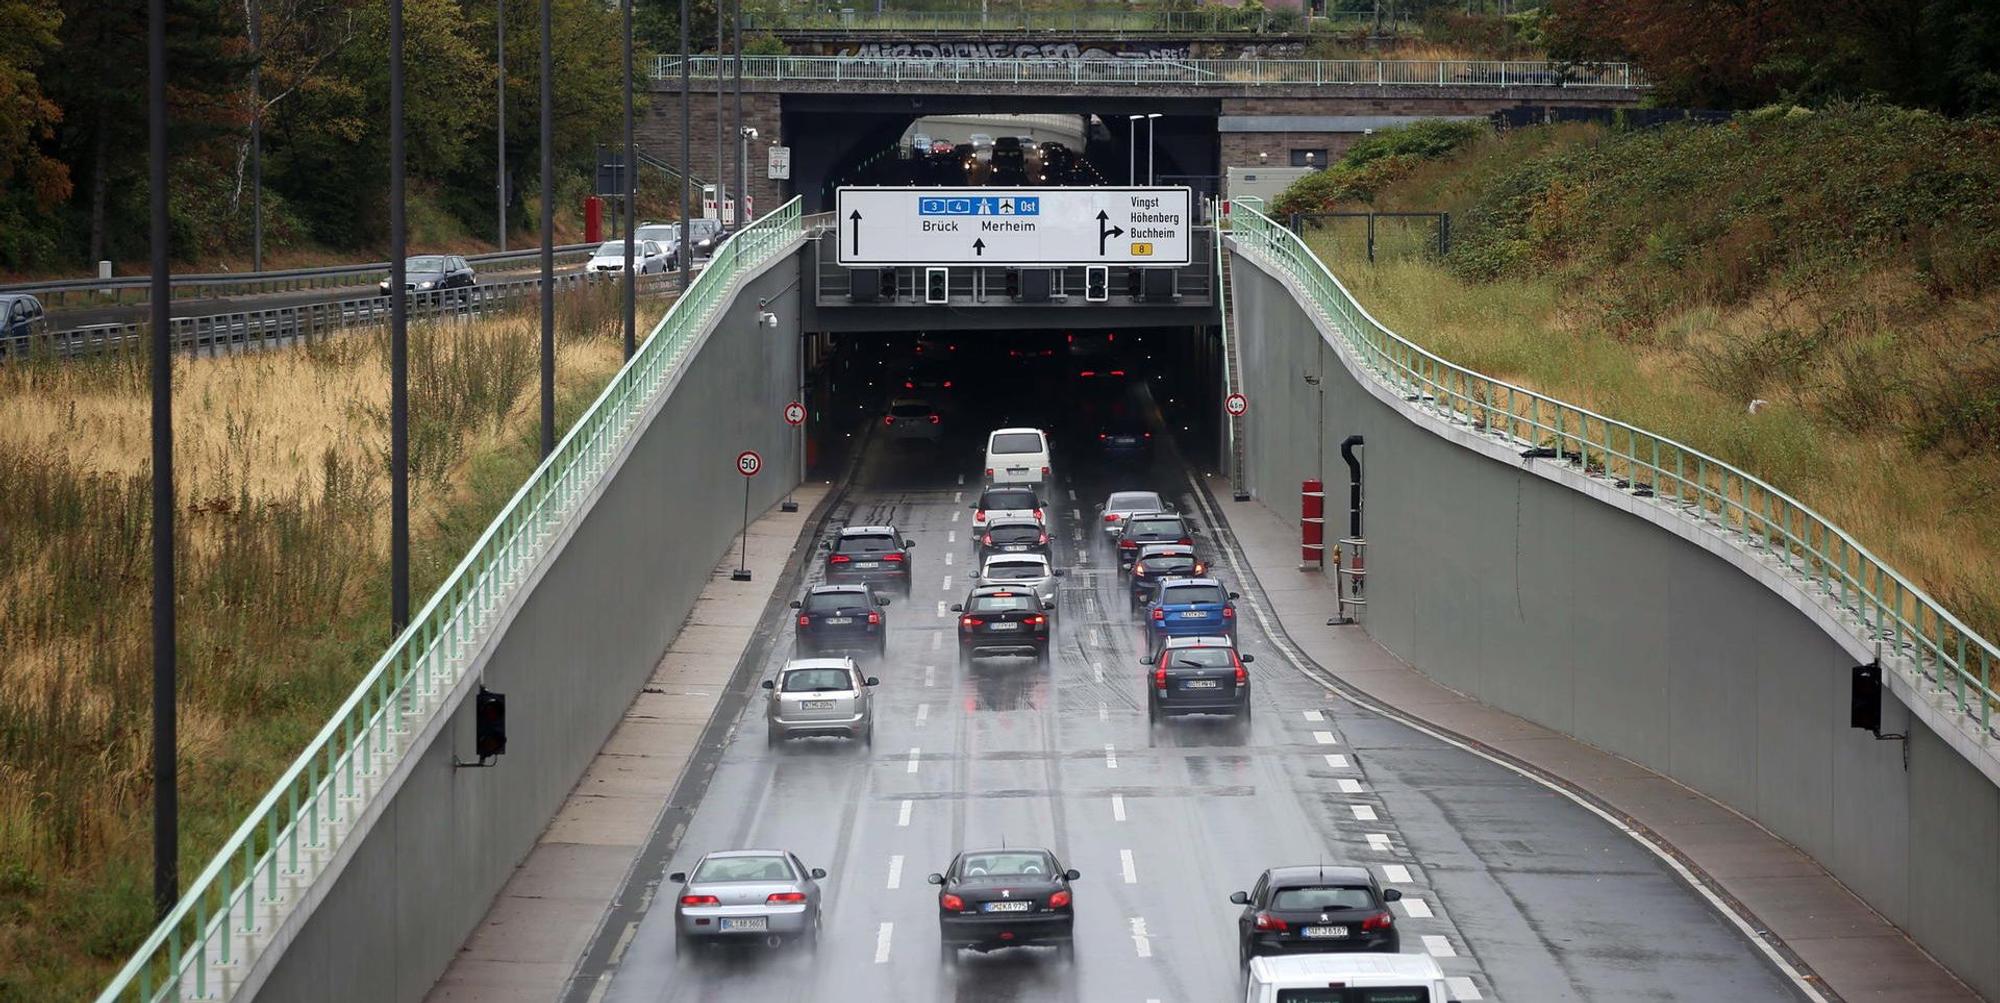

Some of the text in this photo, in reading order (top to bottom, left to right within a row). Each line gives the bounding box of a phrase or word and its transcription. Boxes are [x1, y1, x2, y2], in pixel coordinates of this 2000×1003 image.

[931, 201, 1036, 212] 3 4 Ost
[1131, 196, 1159, 210] Vingst
[1131, 212, 1180, 226] Höhenberg
[922, 220, 1036, 232] Brück Merheim
[1131, 227, 1175, 239] Buchheim
[1139, 245, 1145, 254] 8
[742, 458, 757, 470] 50
